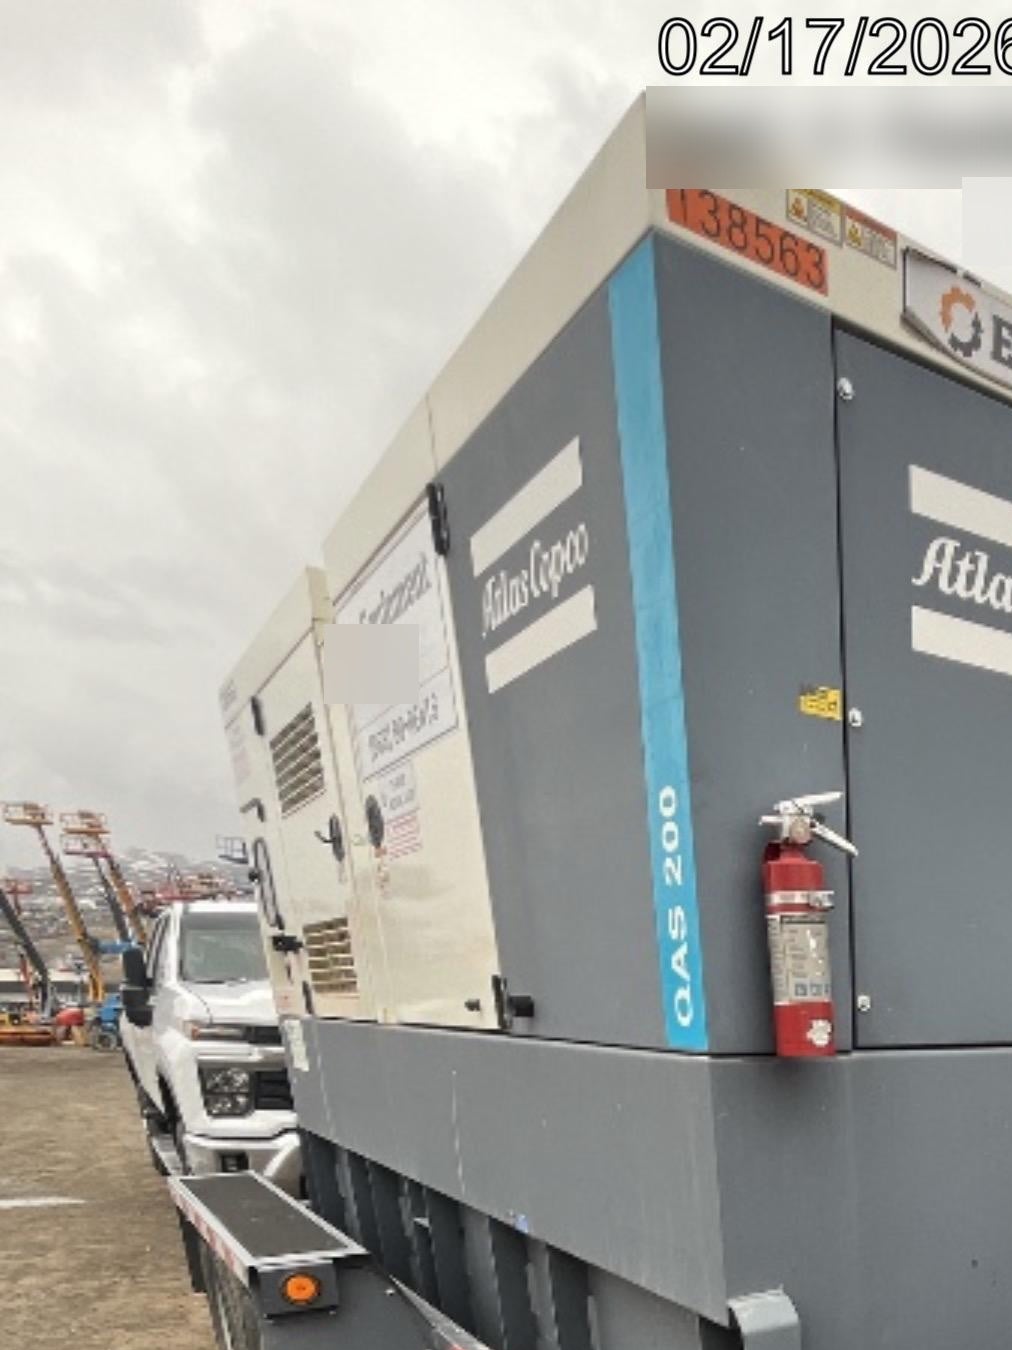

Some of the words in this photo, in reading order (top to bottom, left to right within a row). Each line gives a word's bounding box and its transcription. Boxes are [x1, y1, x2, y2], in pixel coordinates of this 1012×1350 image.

[482, 569, 529, 639] Atlas
[529, 522, 589, 599] Copco
[658, 785, 684, 886] 200
[668, 905, 694, 1028] QAS
